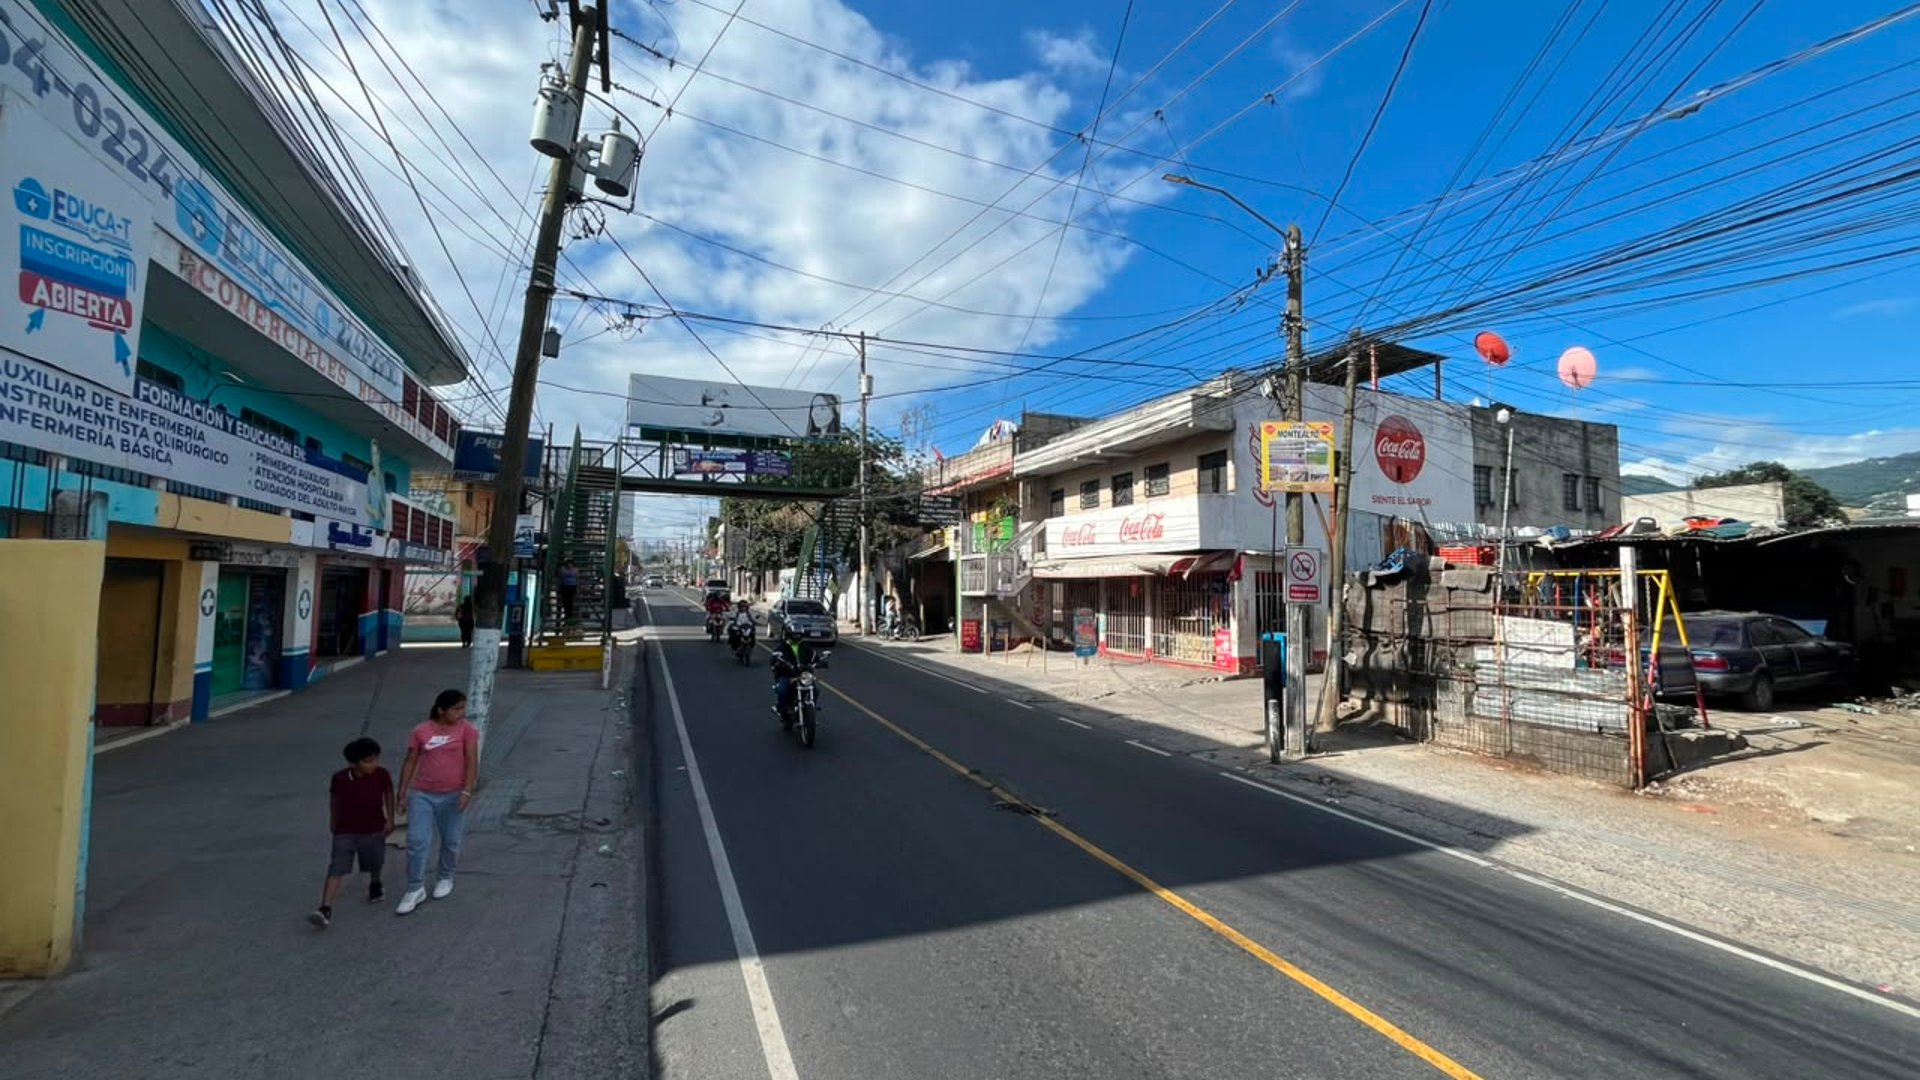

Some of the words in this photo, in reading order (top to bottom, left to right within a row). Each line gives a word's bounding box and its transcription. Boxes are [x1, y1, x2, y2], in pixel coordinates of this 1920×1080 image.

[0, 5, 173, 200] 4-0224
[53, 188, 133, 241] EDUCA-T
[26, 231, 125, 278] INSCRIPCIÓN
[32, 277, 126, 326] ABIERTA
[0, 359, 86, 402] UXILIAR
[91, 391, 115, 412] DE
[118, 400, 206, 443] ENFERMERÍA
[139, 381, 224, 431] FORMACIÓN
[225, 416, 234, 431] Y
[236, 420, 292, 457] EDUCACIÓN
[119, 437, 173, 466] BÁSICA
[153, 429, 229, 465] QUIRÚRGICO
[1277, 430, 1320, 438] MONTEALTO
[1377, 437, 1422, 460] Coca-Cola
[255, 452, 297, 477] PRIMEROS
[298, 467, 330, 487] AUXILIOS
[254, 479, 296, 501] CUIDADOS
[297, 492, 311, 504] DEL
[312, 497, 338, 512] ADULTO
[1371, 495, 1396, 505] SIENTE
[1397, 495, 1406, 504] EL
[1407, 497, 1431, 506] SABOR
[1062, 523, 1097, 548] Coca-Cola
[1119, 512, 1166, 544] Coca-Cola
